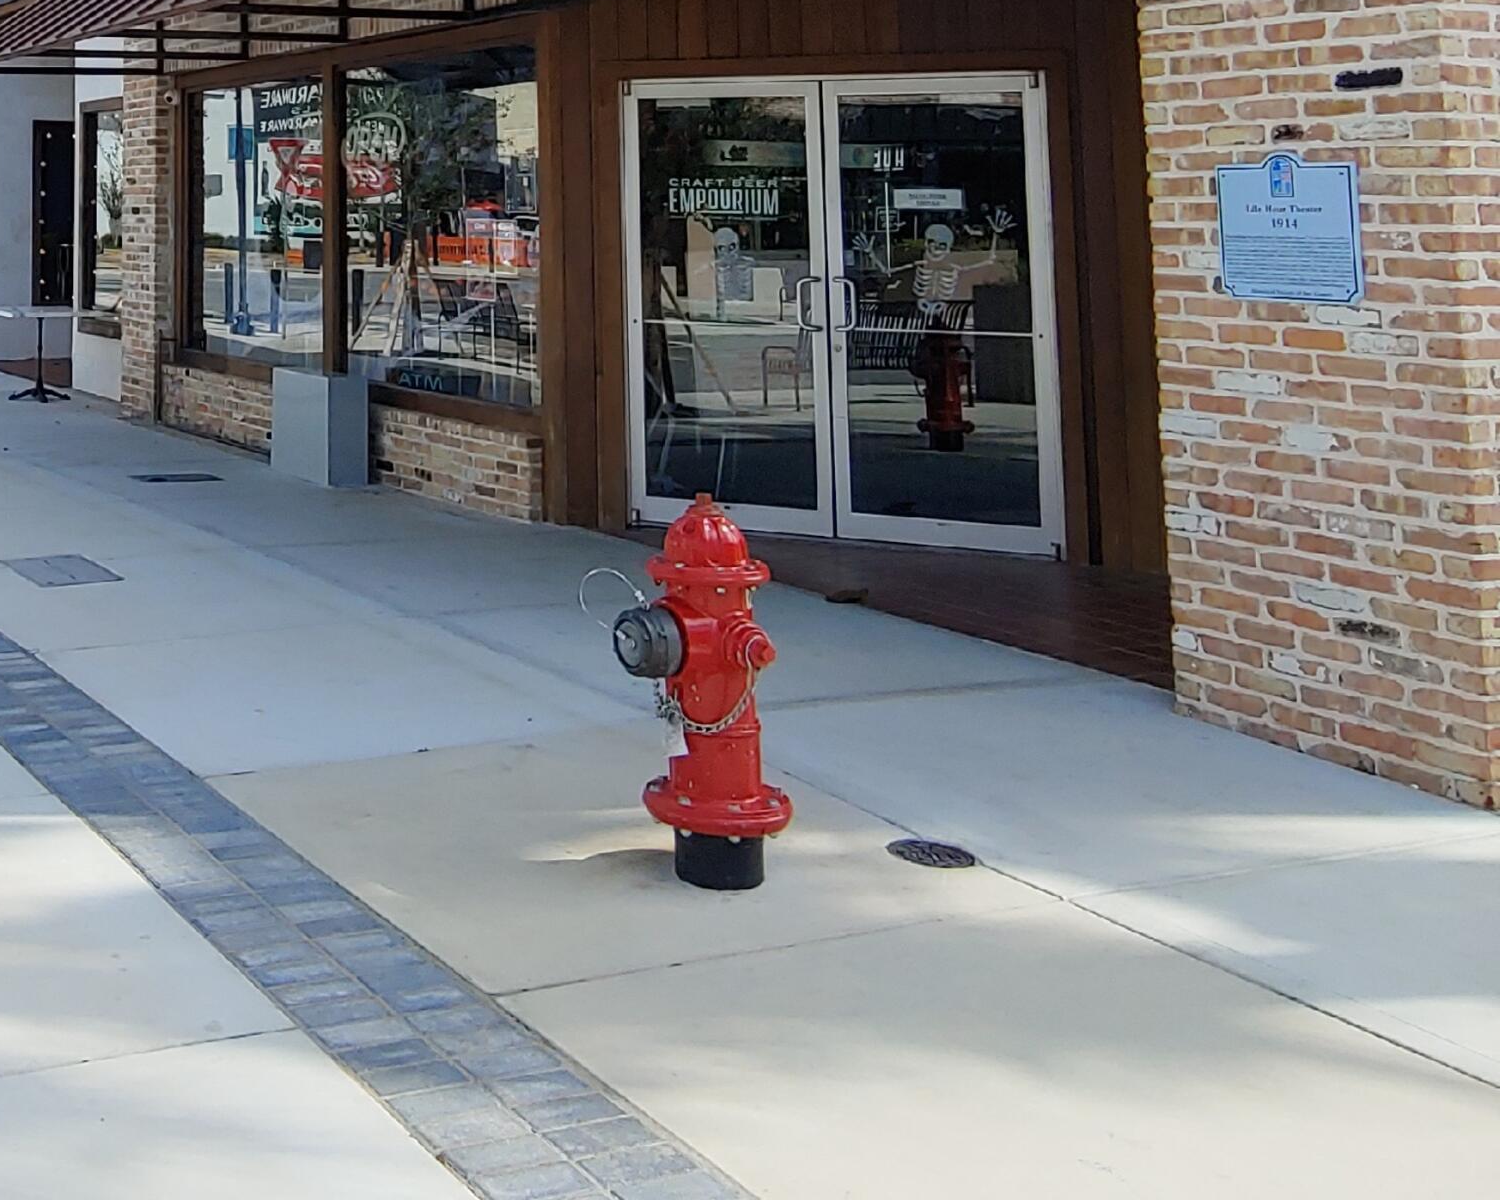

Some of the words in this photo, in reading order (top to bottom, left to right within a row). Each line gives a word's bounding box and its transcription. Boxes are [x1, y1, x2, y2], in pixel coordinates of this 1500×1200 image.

[668, 178, 726, 188] CRAFT
[731, 179, 779, 189] BEER
[668, 187, 780, 216] EMPOURIUM
[1271, 217, 1299, 230] 1914
[398, 371, 443, 392] ATM
